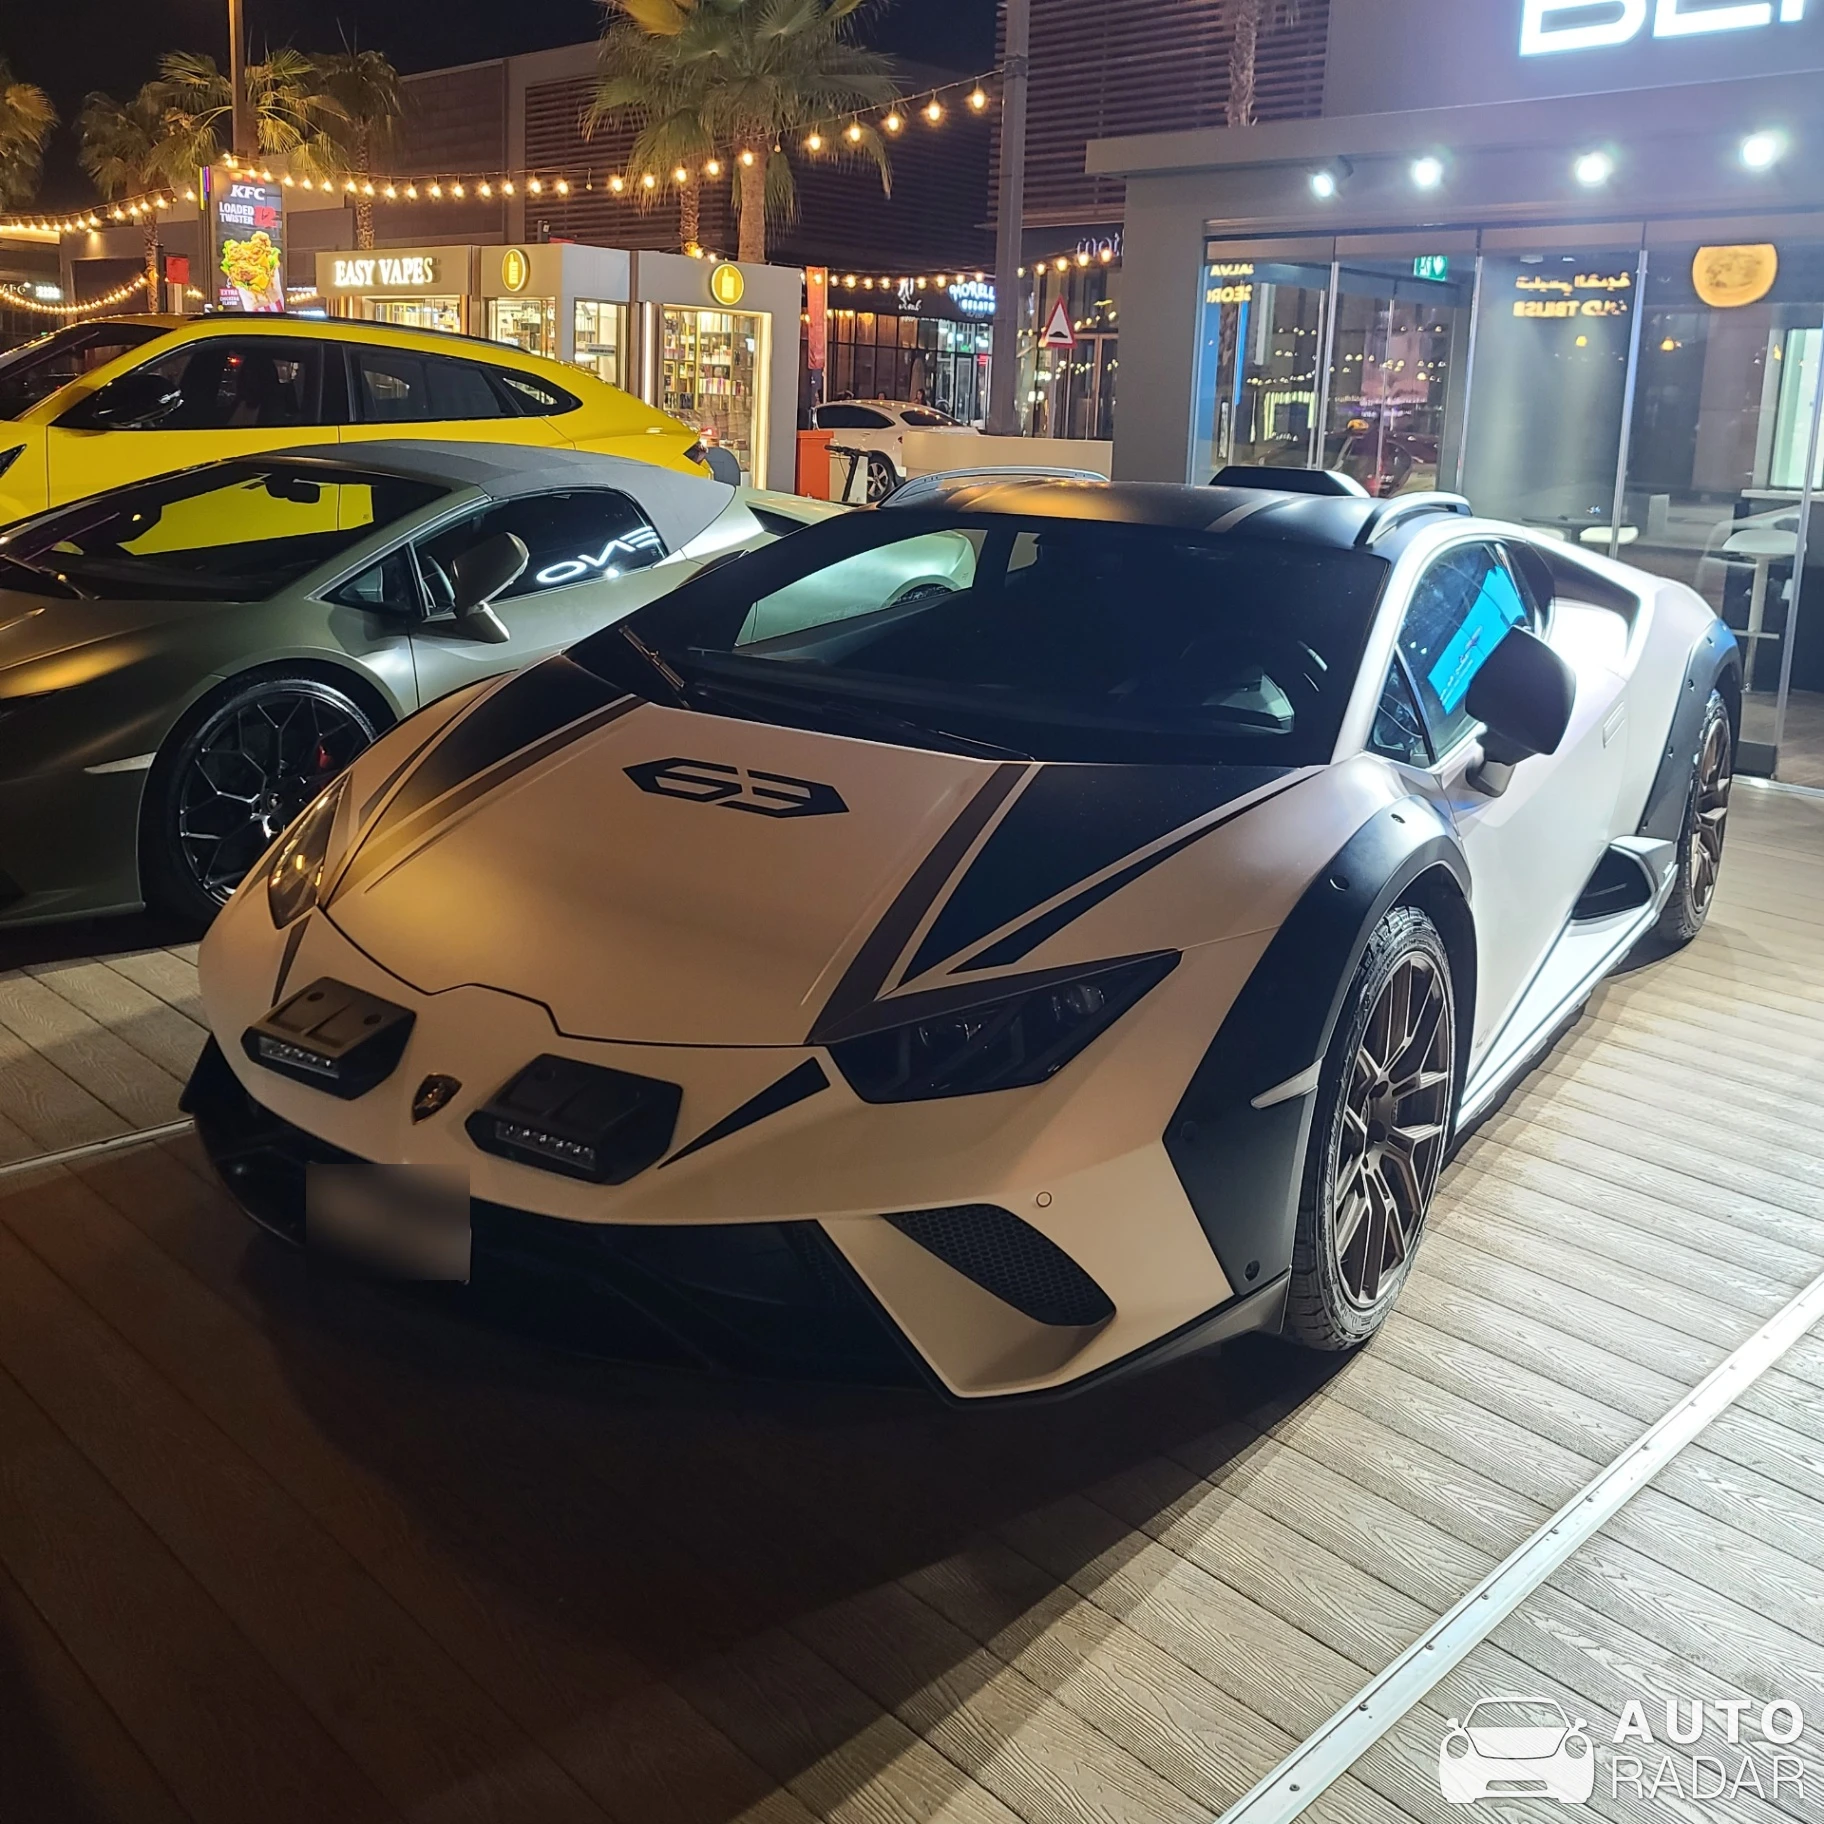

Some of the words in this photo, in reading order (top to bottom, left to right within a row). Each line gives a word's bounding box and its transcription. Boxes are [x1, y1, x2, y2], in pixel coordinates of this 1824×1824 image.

[230, 184, 266, 201] KFC
[218, 201, 255, 216] LOADED
[219, 213, 255, 225] TWISTER
[333, 260, 377, 287] EASY
[378, 257, 433, 285] VAPES
[621, 756, 850, 819] 63
